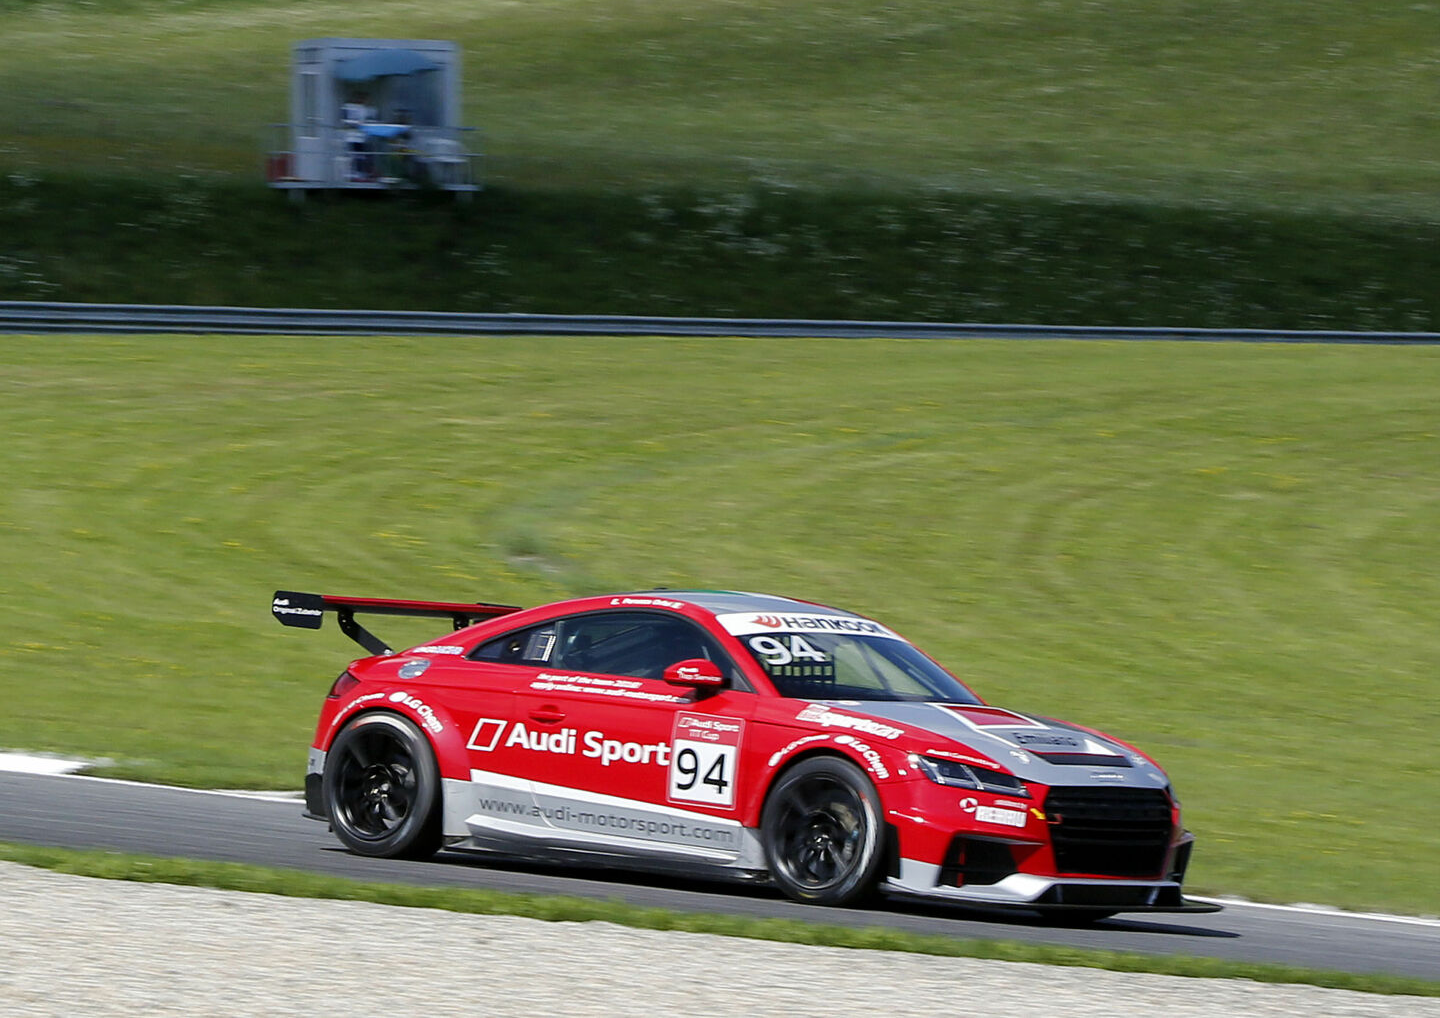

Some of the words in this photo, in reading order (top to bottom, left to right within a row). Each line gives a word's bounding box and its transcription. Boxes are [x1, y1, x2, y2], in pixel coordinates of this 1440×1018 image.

[749, 635, 826, 666] 94
[403, 696, 422, 709] LG
[417, 706, 444, 733] Chem
[690, 718, 712, 728] Audi
[713, 721, 740, 732] Sport
[505, 722, 577, 754] Audi
[582, 731, 670, 766] Sport
[701, 730, 720, 740] Cup
[676, 747, 728, 794] 94
[849, 739, 870, 752] LG
[863, 750, 890, 779] Chem
[479, 796, 734, 844] www.audi-motorsport.com
